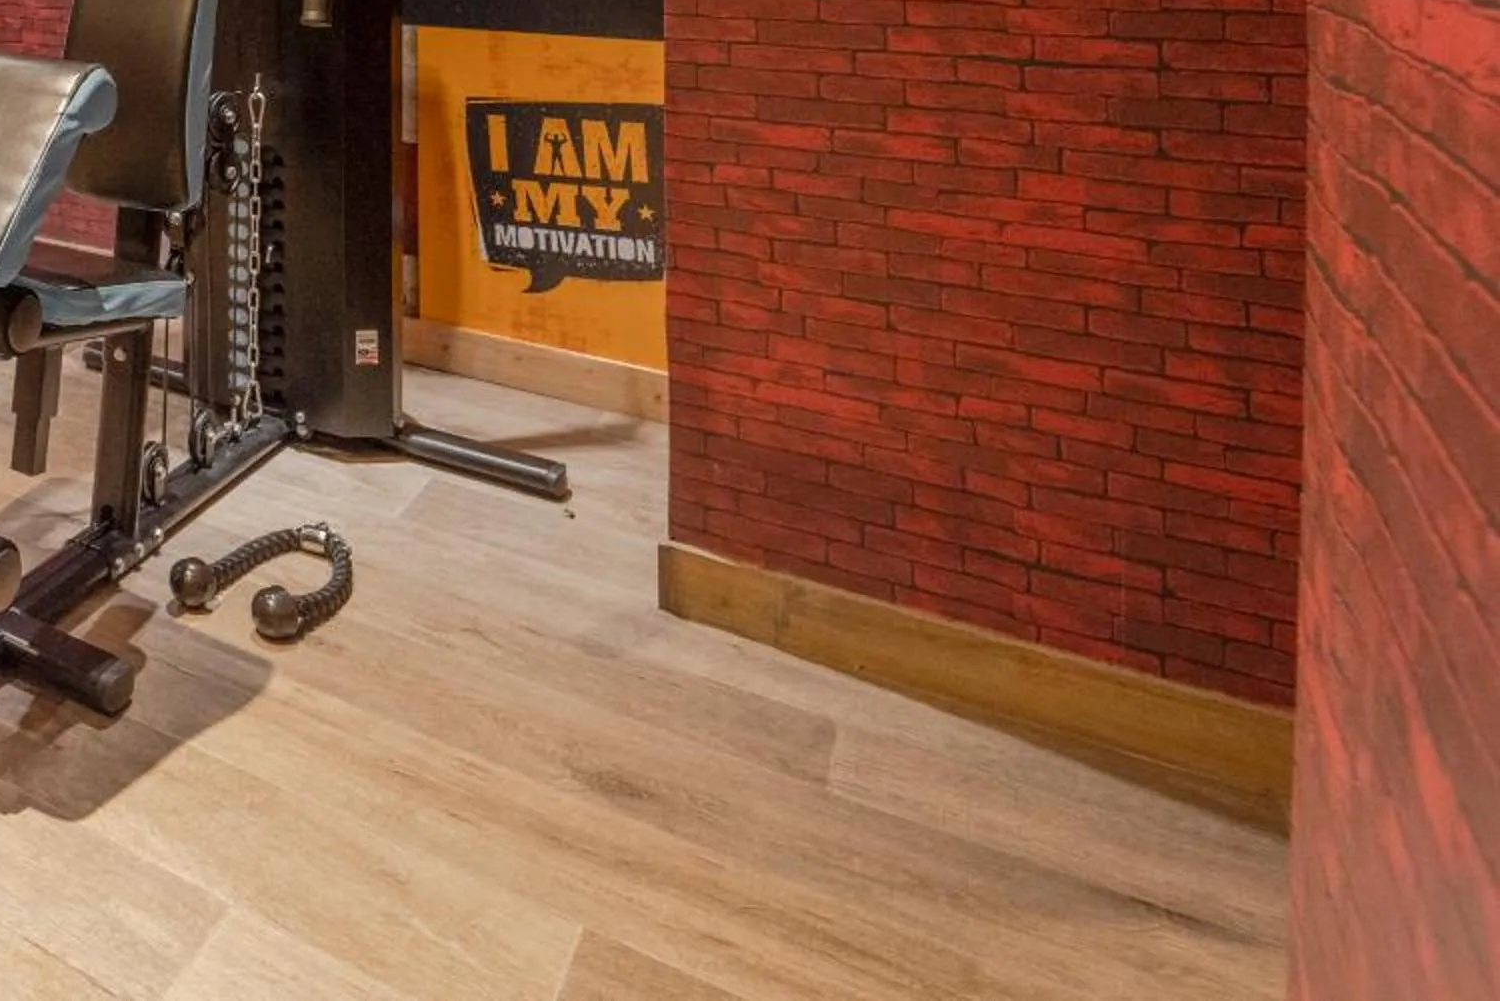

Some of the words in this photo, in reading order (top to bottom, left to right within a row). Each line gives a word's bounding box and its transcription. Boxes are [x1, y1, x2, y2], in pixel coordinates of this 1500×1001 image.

[487, 114, 509, 173] I
[533, 117, 649, 183] AM
[511, 178, 630, 231] MY
[493, 223, 655, 264] MOTIVATION
